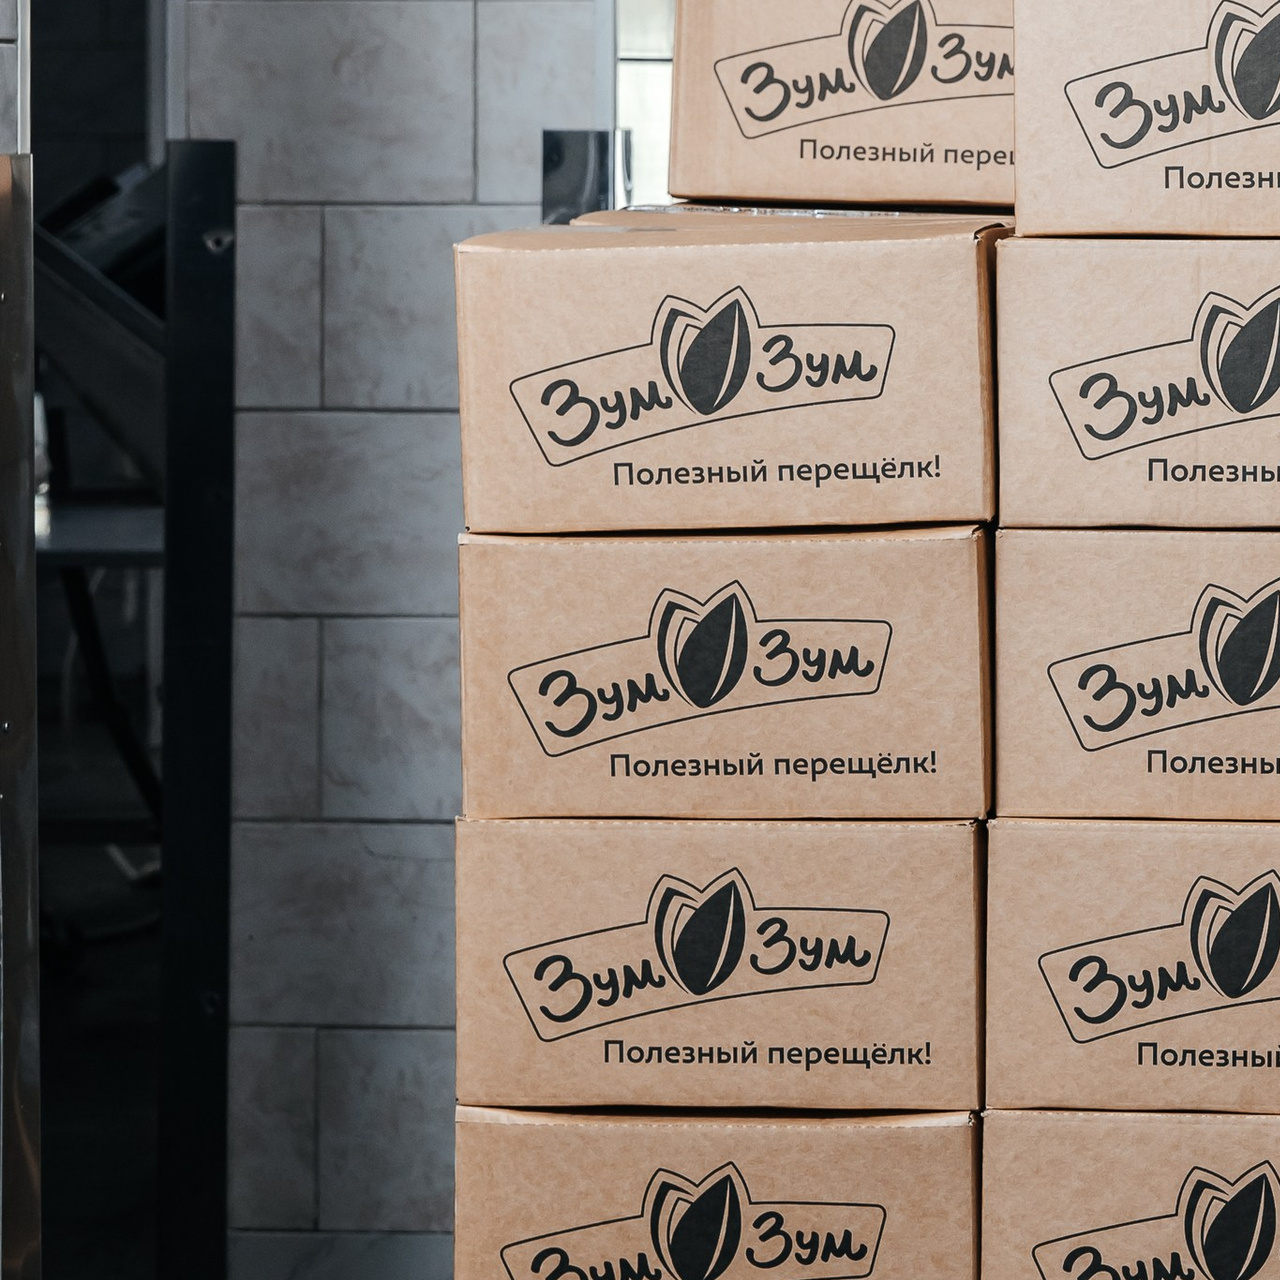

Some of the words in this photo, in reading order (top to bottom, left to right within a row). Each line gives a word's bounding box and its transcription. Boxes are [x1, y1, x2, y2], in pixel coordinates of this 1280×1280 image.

[740, 61, 856, 123] Зум
[1094, 81, 1226, 150] Зум
[799, 138, 935, 163] Полезный
[945, 149, 1014, 170] пере
[540, 378, 673, 448] Зум
[755, 334, 878, 393] Зум
[1078, 372, 1211, 442] Зум
[613, 458, 767, 486] Полезный
[777, 454, 941, 488] перещёлк!
[538, 669, 671, 738] Зум
[752, 628, 875, 687] Зум
[1077, 663, 1210, 733] Зум
[610, 752, 764, 777] Полезный
[774, 750, 937, 783] перещёлк!
[533, 954, 667, 1023] Зум
[749, 916, 872, 976] Зум
[1068, 955, 1201, 1025] Зум
[604, 1039, 758, 1064] Полезный
[768, 1041, 932, 1072] перещёлк!
[745, 1210, 868, 1269] Зум
